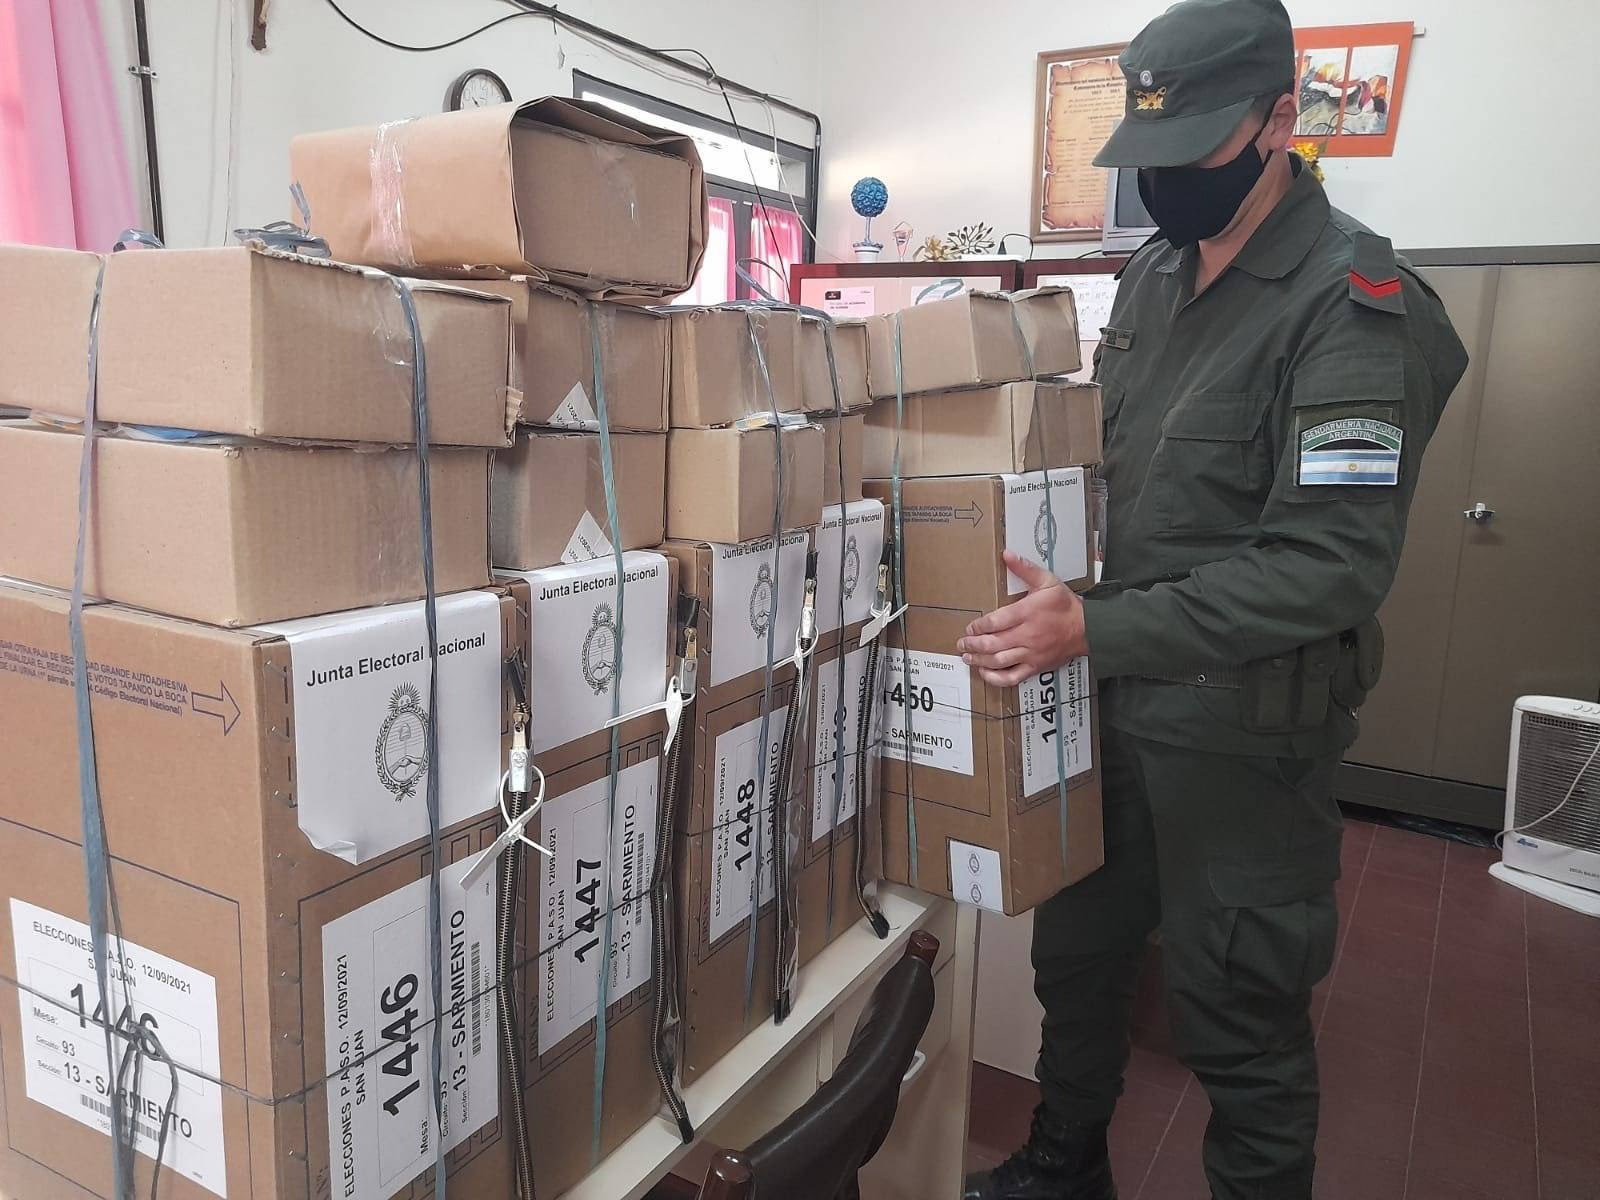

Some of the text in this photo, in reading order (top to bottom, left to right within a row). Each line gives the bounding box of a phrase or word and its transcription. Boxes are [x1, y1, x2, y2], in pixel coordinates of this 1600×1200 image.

[1303, 420, 1401, 440] GENDARMERIA NACIONAL
[1328, 430, 1376, 440] ARGENTINA
[1009, 485, 1027, 495] Junta
[1053, 477, 1078, 487] Nacional
[822, 519, 838, 530] Junta
[861, 511, 882, 523] Nacional
[722, 548, 743, 560] Junta
[778, 534, 805, 547] acional
[540, 565, 659, 600] Junta Electoral acional
[306, 632, 486, 687] Junta Electoral acional
[94, 674, 118, 687] VOTOS
[119, 679, 152, 696] TAPANDO
[154, 688, 164, 699] LA
[165, 690, 187, 705] BOCA
[100, 664, 131, 679] GRANDE
[131, 671, 188, 693] AUTOADHESIVA
[1068, 659, 1077, 719] SARMIEN
[119, 690, 149, 706] Electoral
[149, 697, 183, 717] Nacional)
[1039, 670, 1057, 743] 1450
[891, 728, 953, 750] SARMIENTO
[1024, 725, 1033, 777] ELECCIONES
[1070, 729, 1077, 745] 13
[734, 778, 756, 872] 1448
[621, 804, 635, 918] SARMIENTO
[715, 855, 723, 918] ELECCIONES
[557, 889, 565, 950] SAN JUAN
[574, 858, 602, 963] 1447
[32, 920, 94, 952] ELECCIONES
[142, 963, 191, 995] 12/09/2021
[609, 942, 618, 959] 93
[620, 930, 631, 952] 13
[450, 909, 466, 1048] SARMIENTO
[546, 948, 556, 1022] ELECCIONES
[62, 1040, 76, 1057] 93
[380, 972, 421, 1118] 1446
[63, 1062, 81, 1083] 13
[337, 954, 355, 1199] ELECCIONES P.A.S.O. 12/09/2021
[353, 1029, 366, 1106] SAN JUAN
[452, 1065, 466, 1092] 13
[420, 1116, 429, 1155] Mesa:
